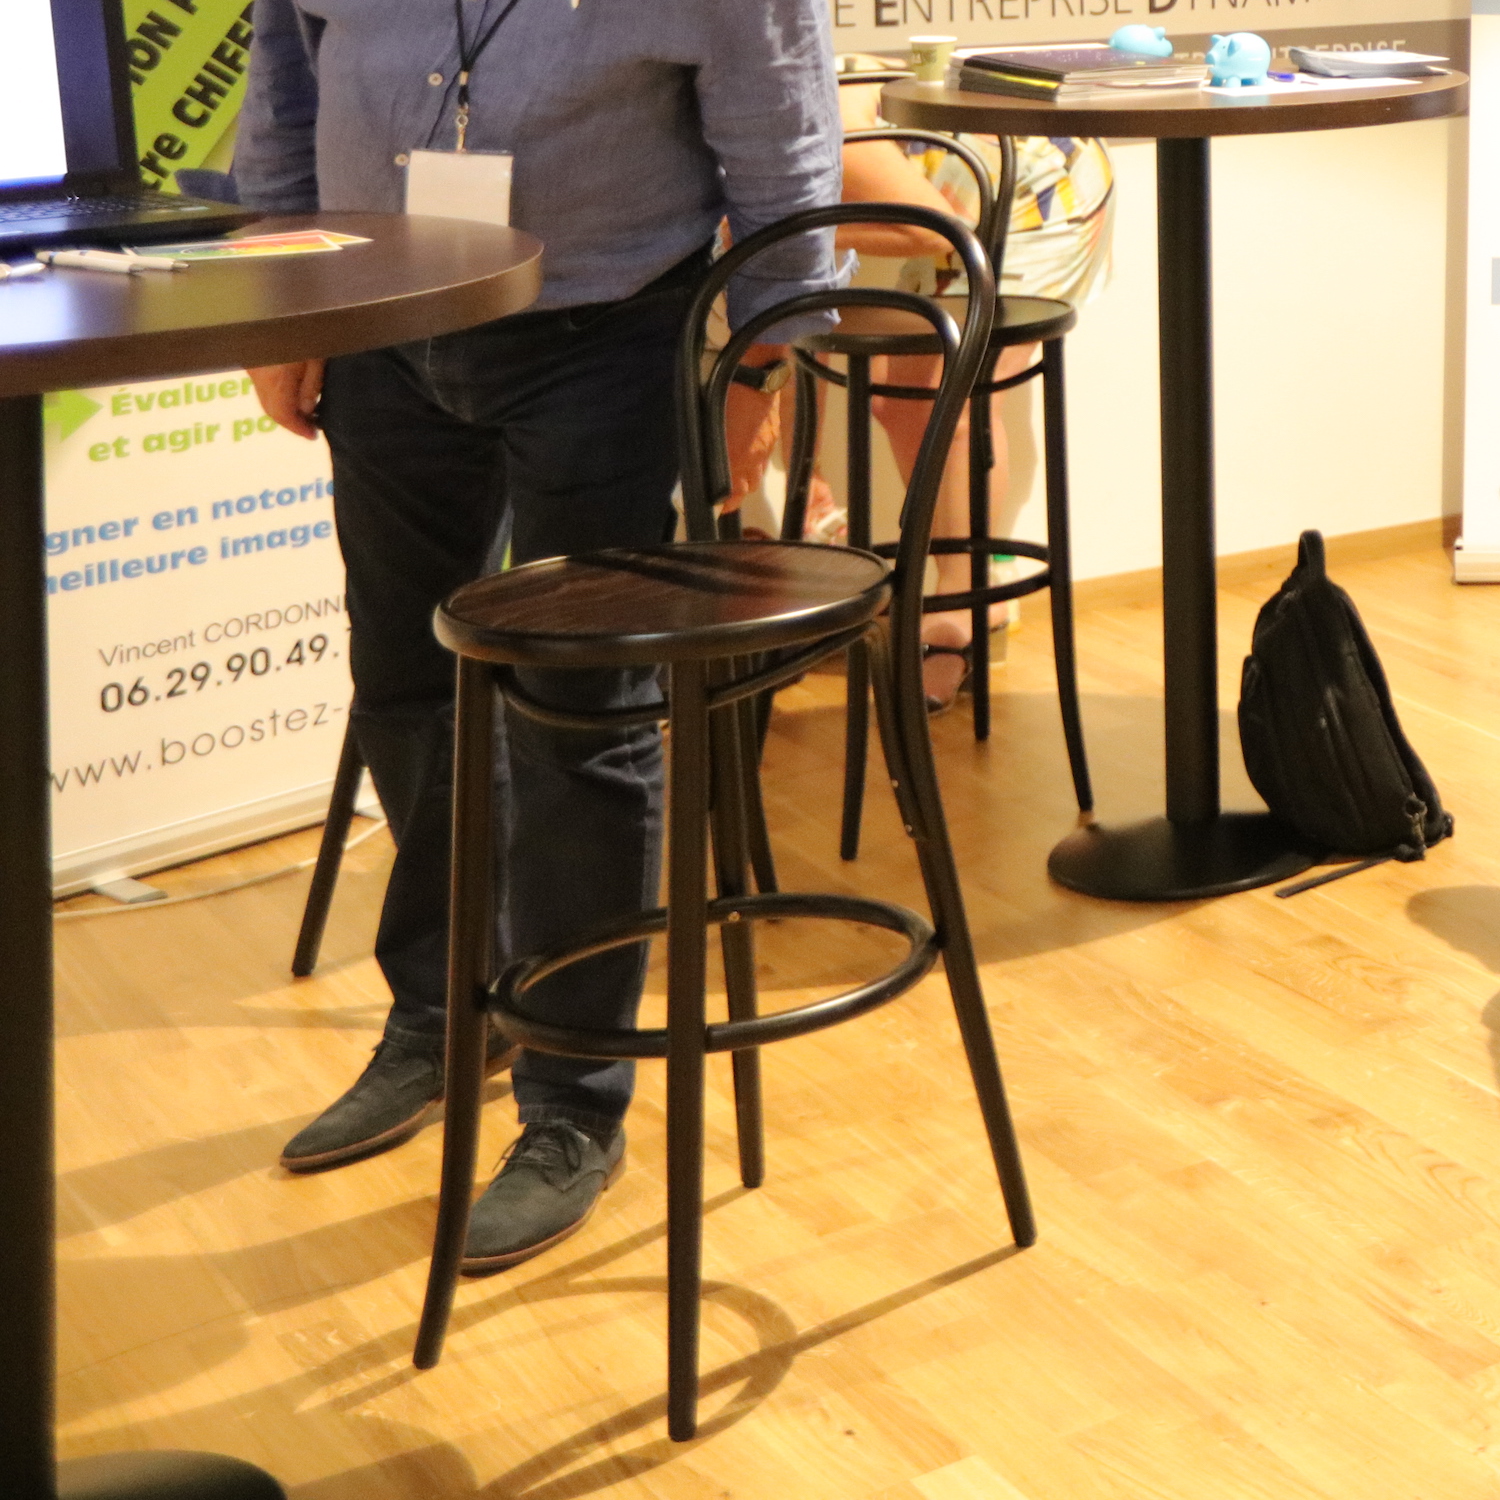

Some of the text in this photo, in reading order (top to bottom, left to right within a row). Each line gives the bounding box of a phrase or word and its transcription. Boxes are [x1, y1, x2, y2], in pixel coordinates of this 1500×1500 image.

[172, 1, 255, 129] CHIFF
[88, 414, 278, 462] et agir po
[45, 516, 139, 558] gner
[152, 505, 199, 531] en
[46, 519, 333, 596] eilleure image
[98, 629, 197, 667] Vincent
[100, 628, 351, 713] 06.29.90.49.
